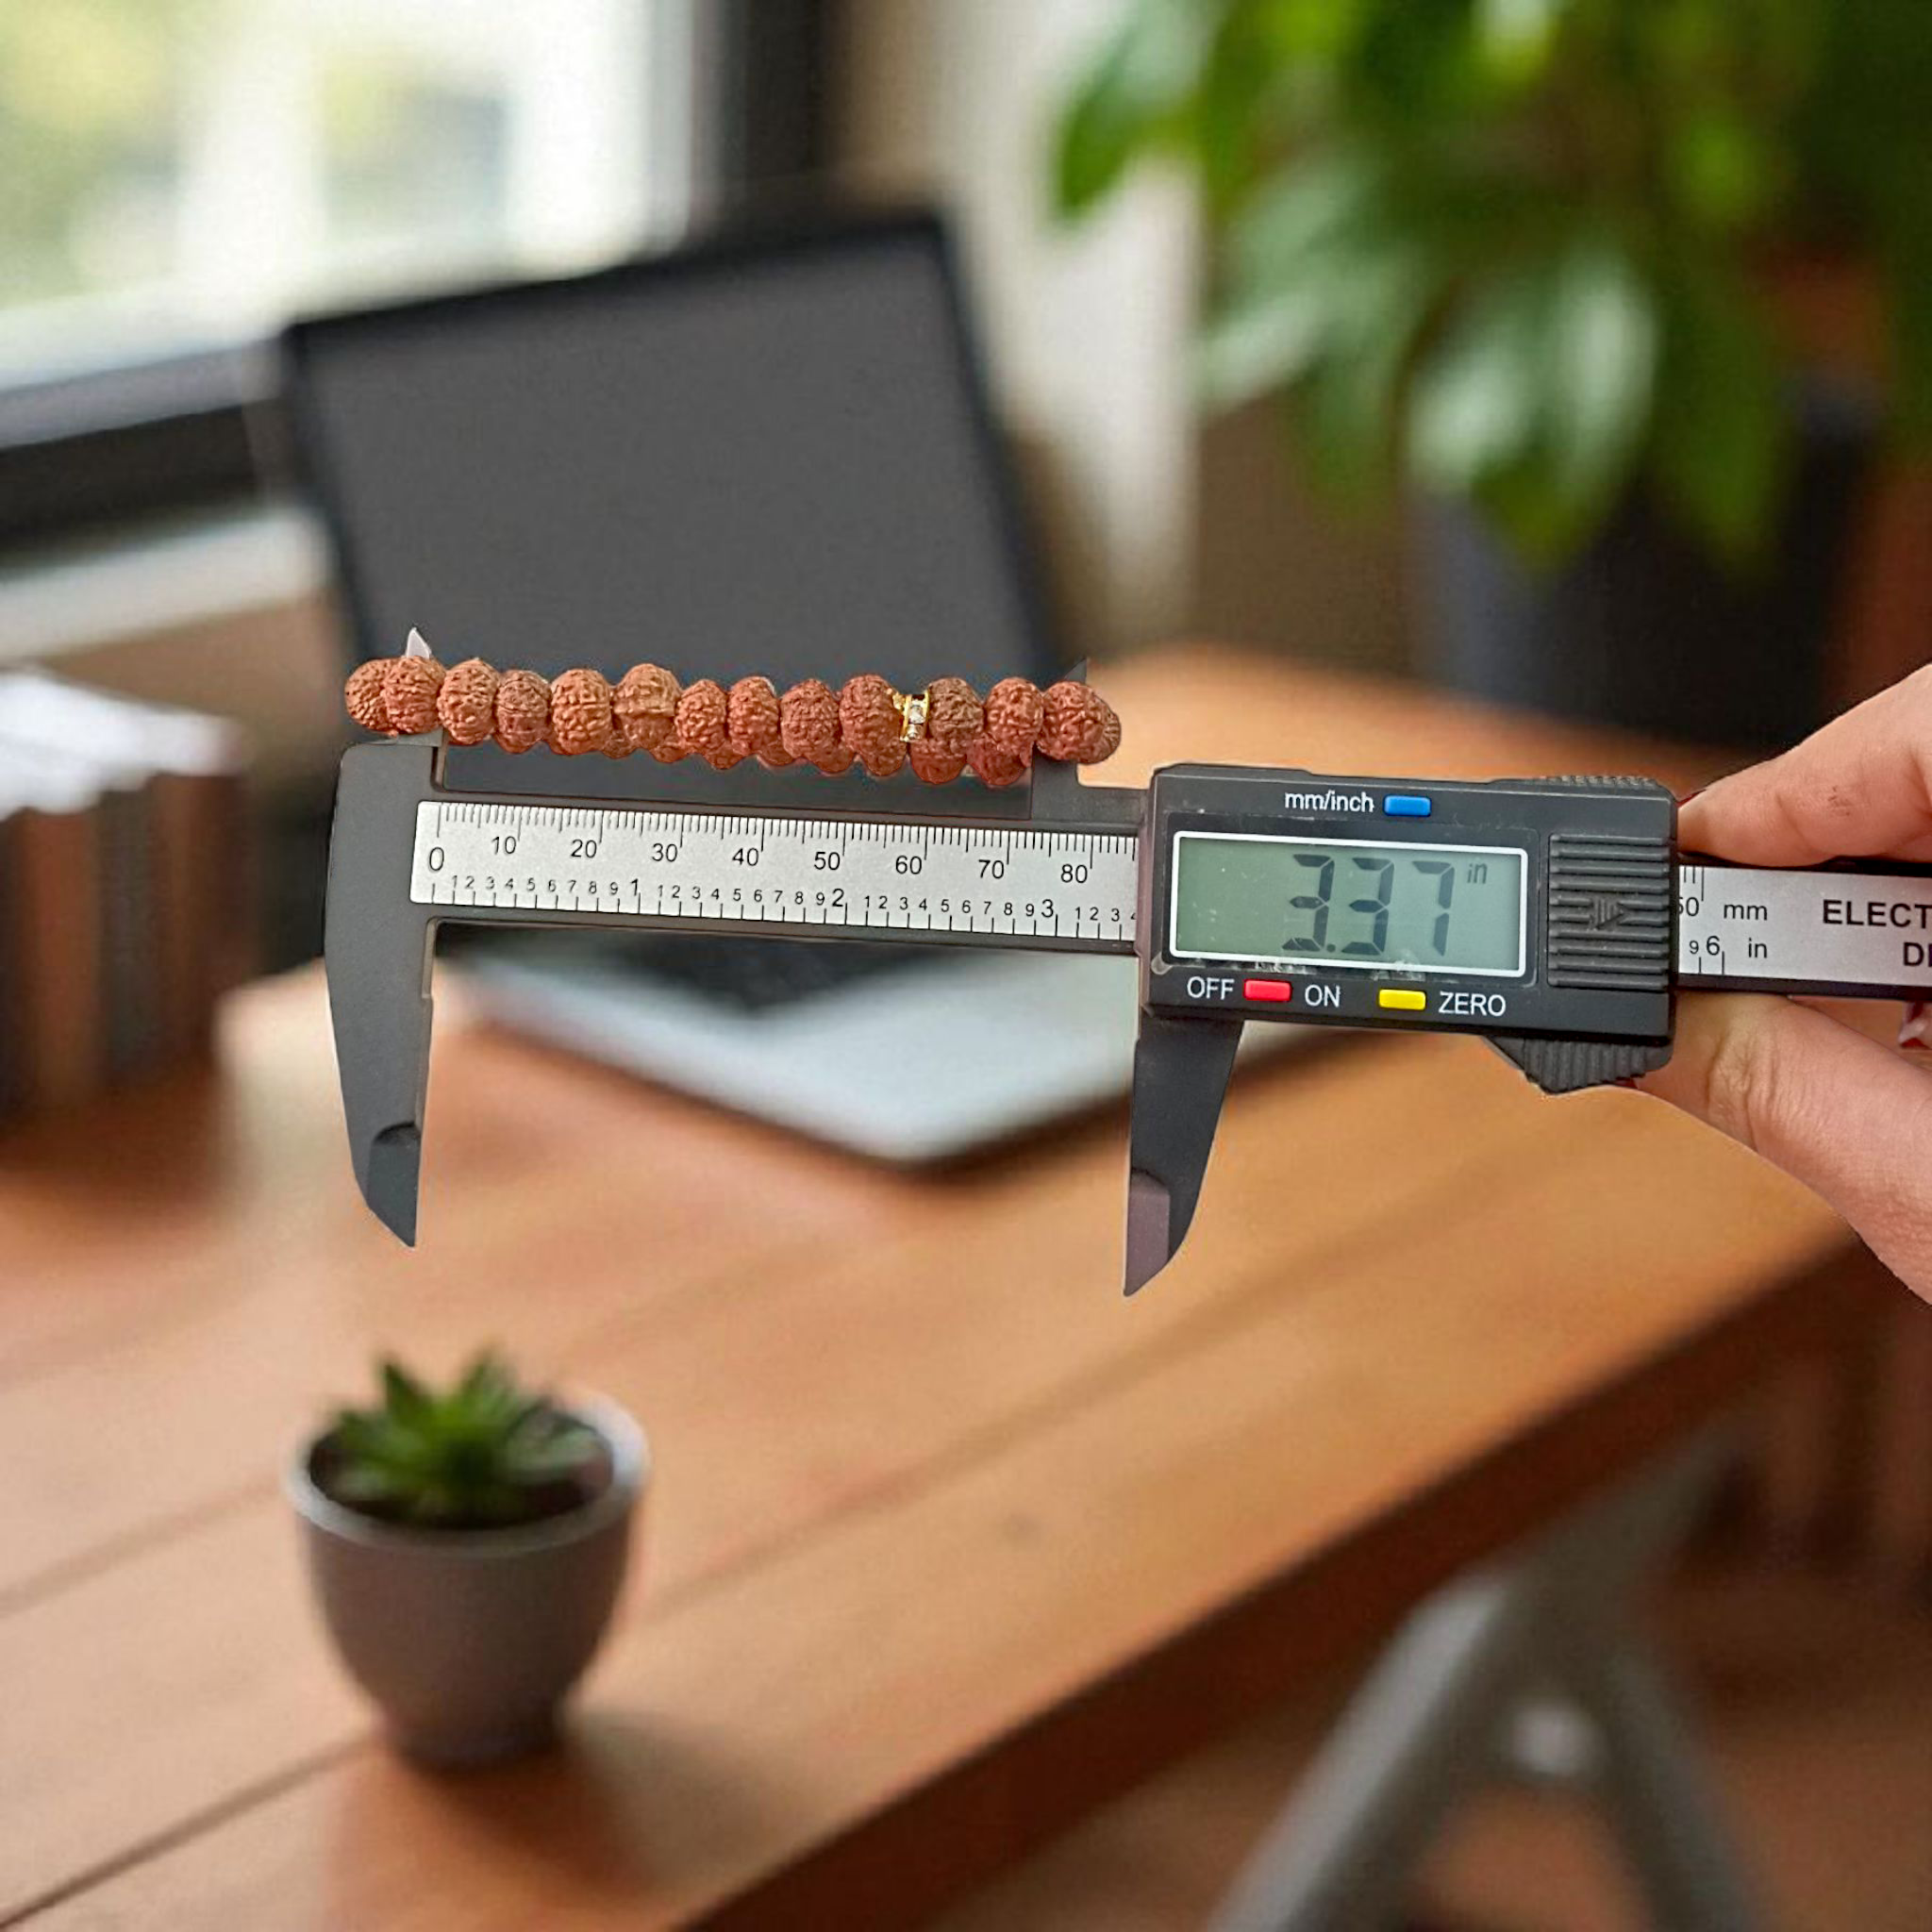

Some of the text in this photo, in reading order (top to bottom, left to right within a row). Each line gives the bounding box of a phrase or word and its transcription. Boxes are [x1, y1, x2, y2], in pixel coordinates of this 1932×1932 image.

[1284, 790, 1374, 813] mm/inch
[428, 836, 1088, 884] 0 10 20 30 40 50 60 70 80
[465, 875, 475, 890] 2
[486, 875, 495, 890] 3
[505, 877, 514, 891] 4
[526, 877, 536, 891] 5
[548, 878, 557, 892] 6
[568, 879, 577, 892] 7
[588, 880, 597, 894] 8
[609, 881, 619, 895] 9
[630, 878, 639, 897] 1
[671, 885, 681, 899] 2
[691, 886, 701, 900] 3
[710, 888, 721, 900] 4
[732, 888, 741, 902] 5
[753, 889, 763, 903] 6
[774, 890, 783, 903] 7
[794, 891, 804, 906] 8
[815, 891, 825, 907] 9
[831, 888, 844, 908] 2
[878, 895, 888, 909] 2
[899, 896, 908, 910] 3
[918, 898, 927, 911] 4
[941, 898, 950, 913] 5
[961, 900, 971, 914] 6
[982, 901, 991, 915] 7
[1003, 902, 1013, 916] 8
[1025, 903, 1035, 917] 9
[1041, 898, 1054, 919] 3
[1090, 907, 1099, 921] 2
[1110, 908, 1120, 923] 3
[1281, 853, 1489, 958] 3.37 in
[1724, 904, 1768, 921] mm
[1689, 935, 1768, 958] 9 6 in
[1187, 975, 1235, 1000] OFF
[1305, 984, 1341, 1008] ON
[1438, 991, 1507, 1017] ZERO
